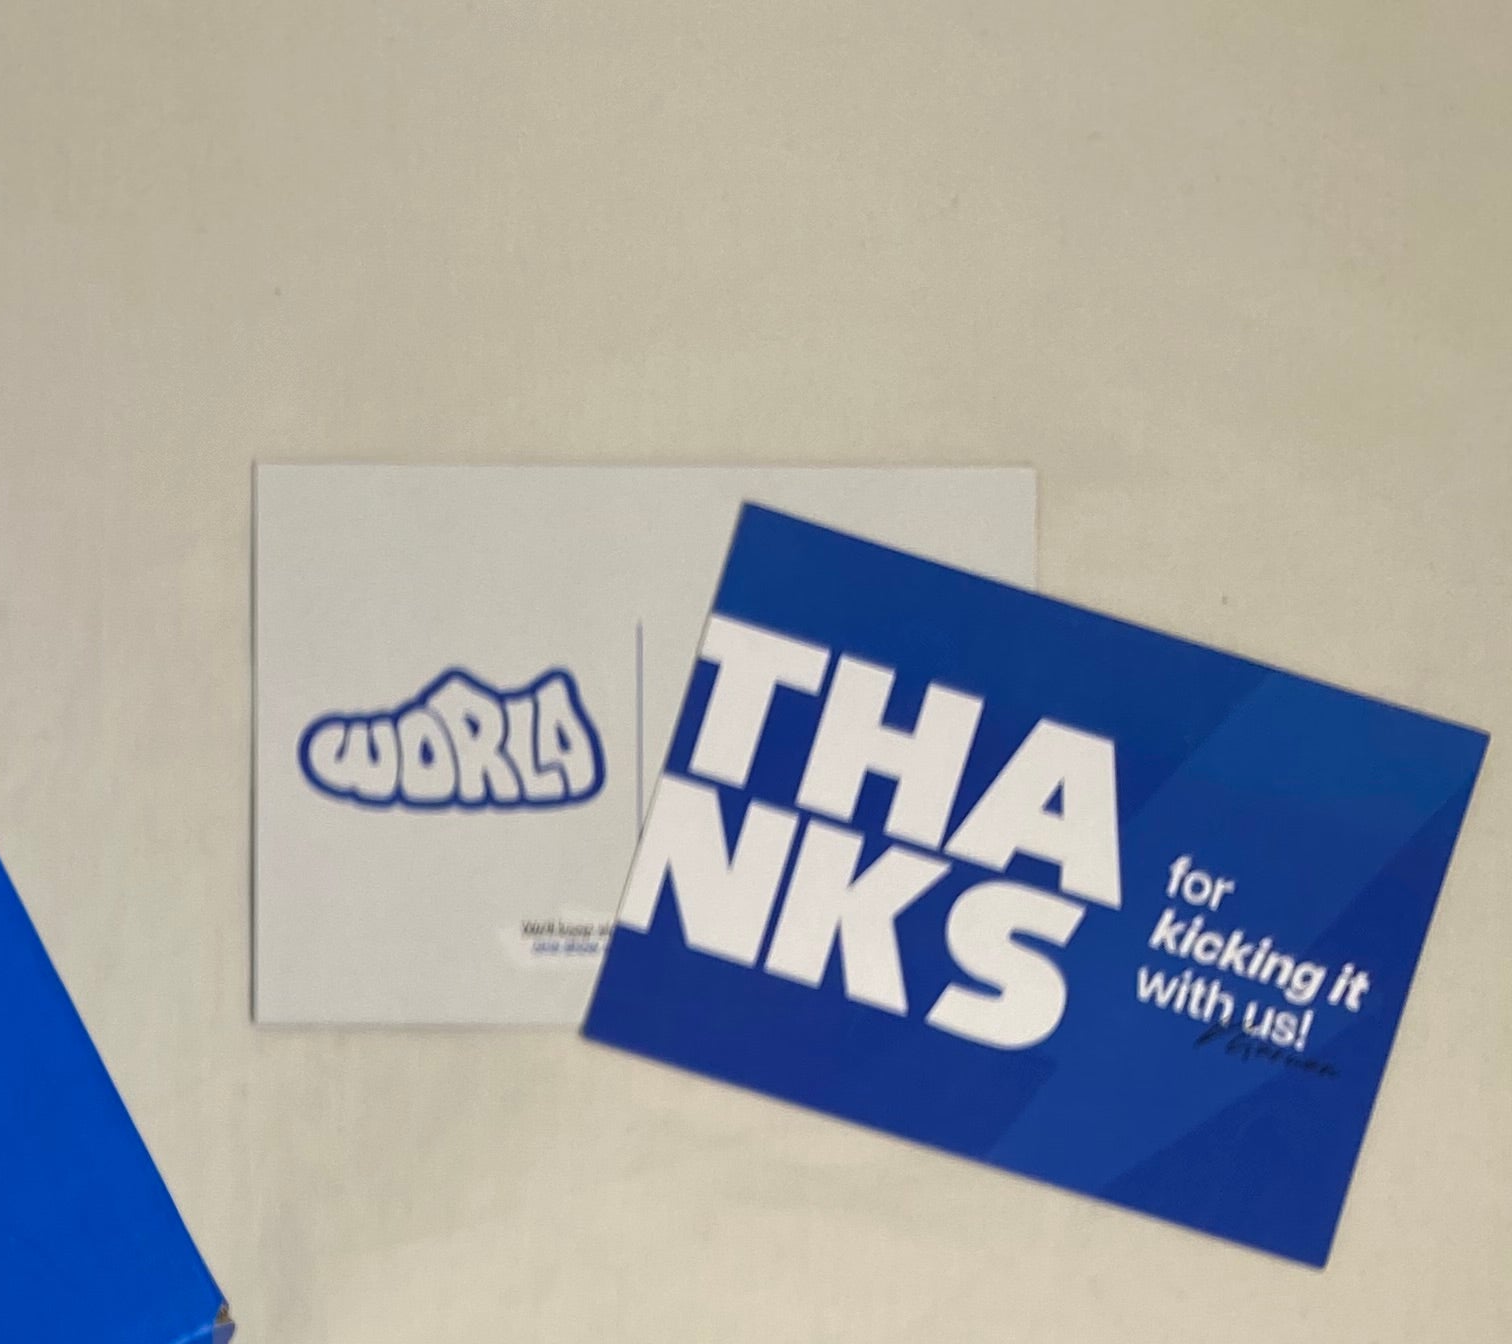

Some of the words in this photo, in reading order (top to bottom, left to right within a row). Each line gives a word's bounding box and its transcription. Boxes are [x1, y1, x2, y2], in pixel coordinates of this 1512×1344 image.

[1166, 853, 1236, 912] for
[1148, 906, 1328, 1006] kicking
[1327, 962, 1371, 1013] it
[1136, 964, 1235, 1029] with
[1241, 1000, 1315, 1052] us!
